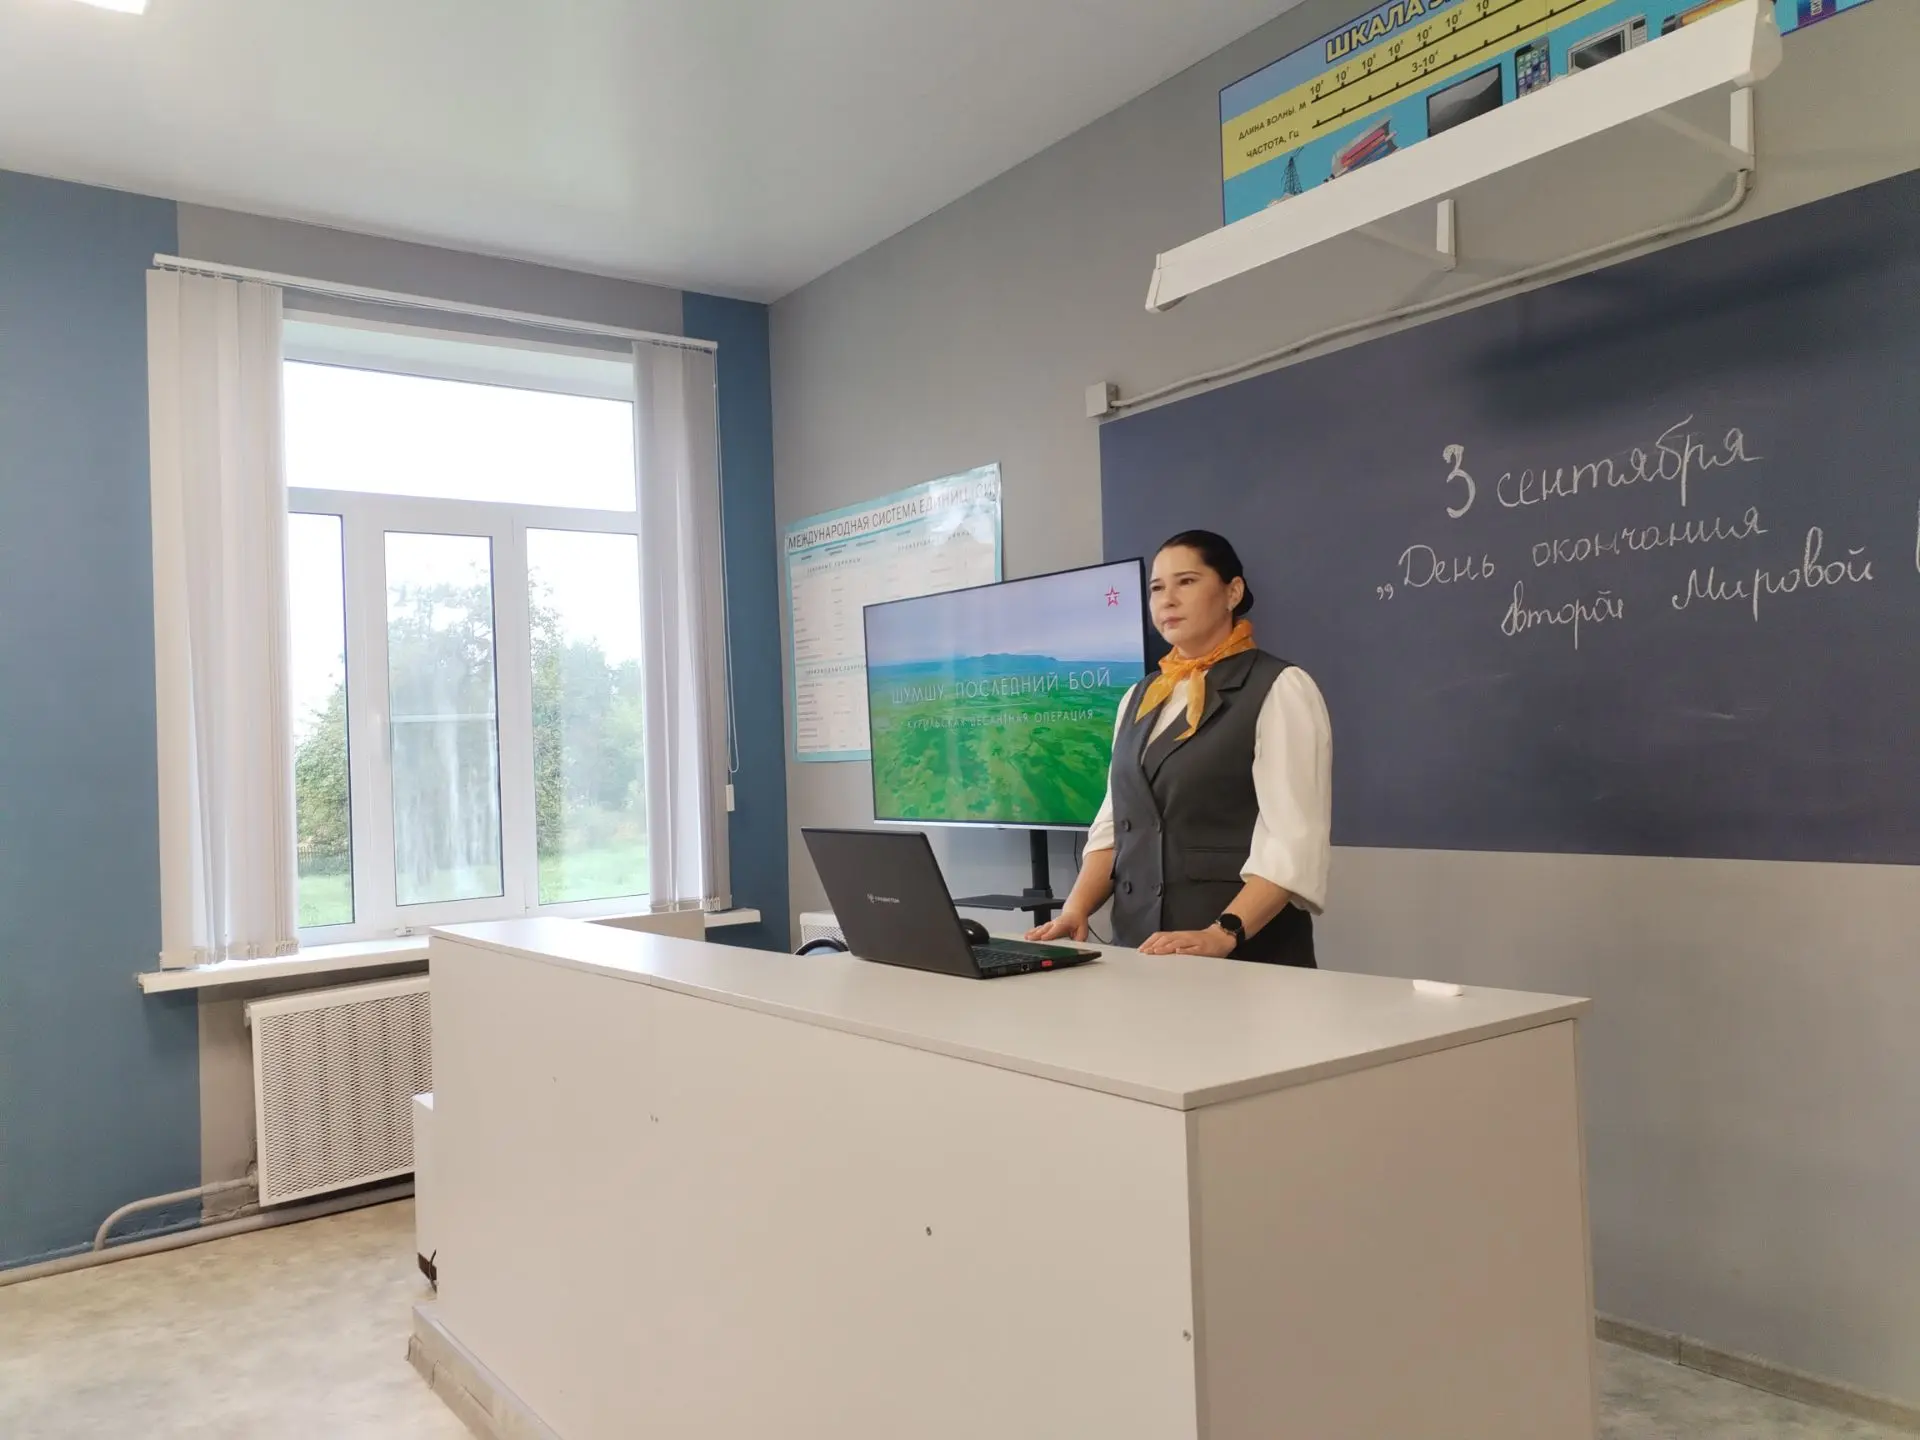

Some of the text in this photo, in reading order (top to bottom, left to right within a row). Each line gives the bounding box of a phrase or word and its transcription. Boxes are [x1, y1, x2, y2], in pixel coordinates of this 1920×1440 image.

[1326, 0, 1425, 63] ШКАЛА
[1238, 122, 1265, 140] ДЛИНА
[1246, 129, 1299, 158] ЧАСТОТА, Гц
[1442, 414, 1763, 518] 3 сентября
[788, 516, 870, 549] МЕЖДУНАРОДНАЯ
[872, 502, 917, 527] СИСТЕМА
[1532, 506, 1769, 567] окончания
[1672, 526, 1874, 621] Мировой
[892, 666, 1112, 704] ШУМШУ ПОСЛЕДНИЙ БОЙ
[1034, 708, 1094, 724] ОПЕРАЦИЯ
